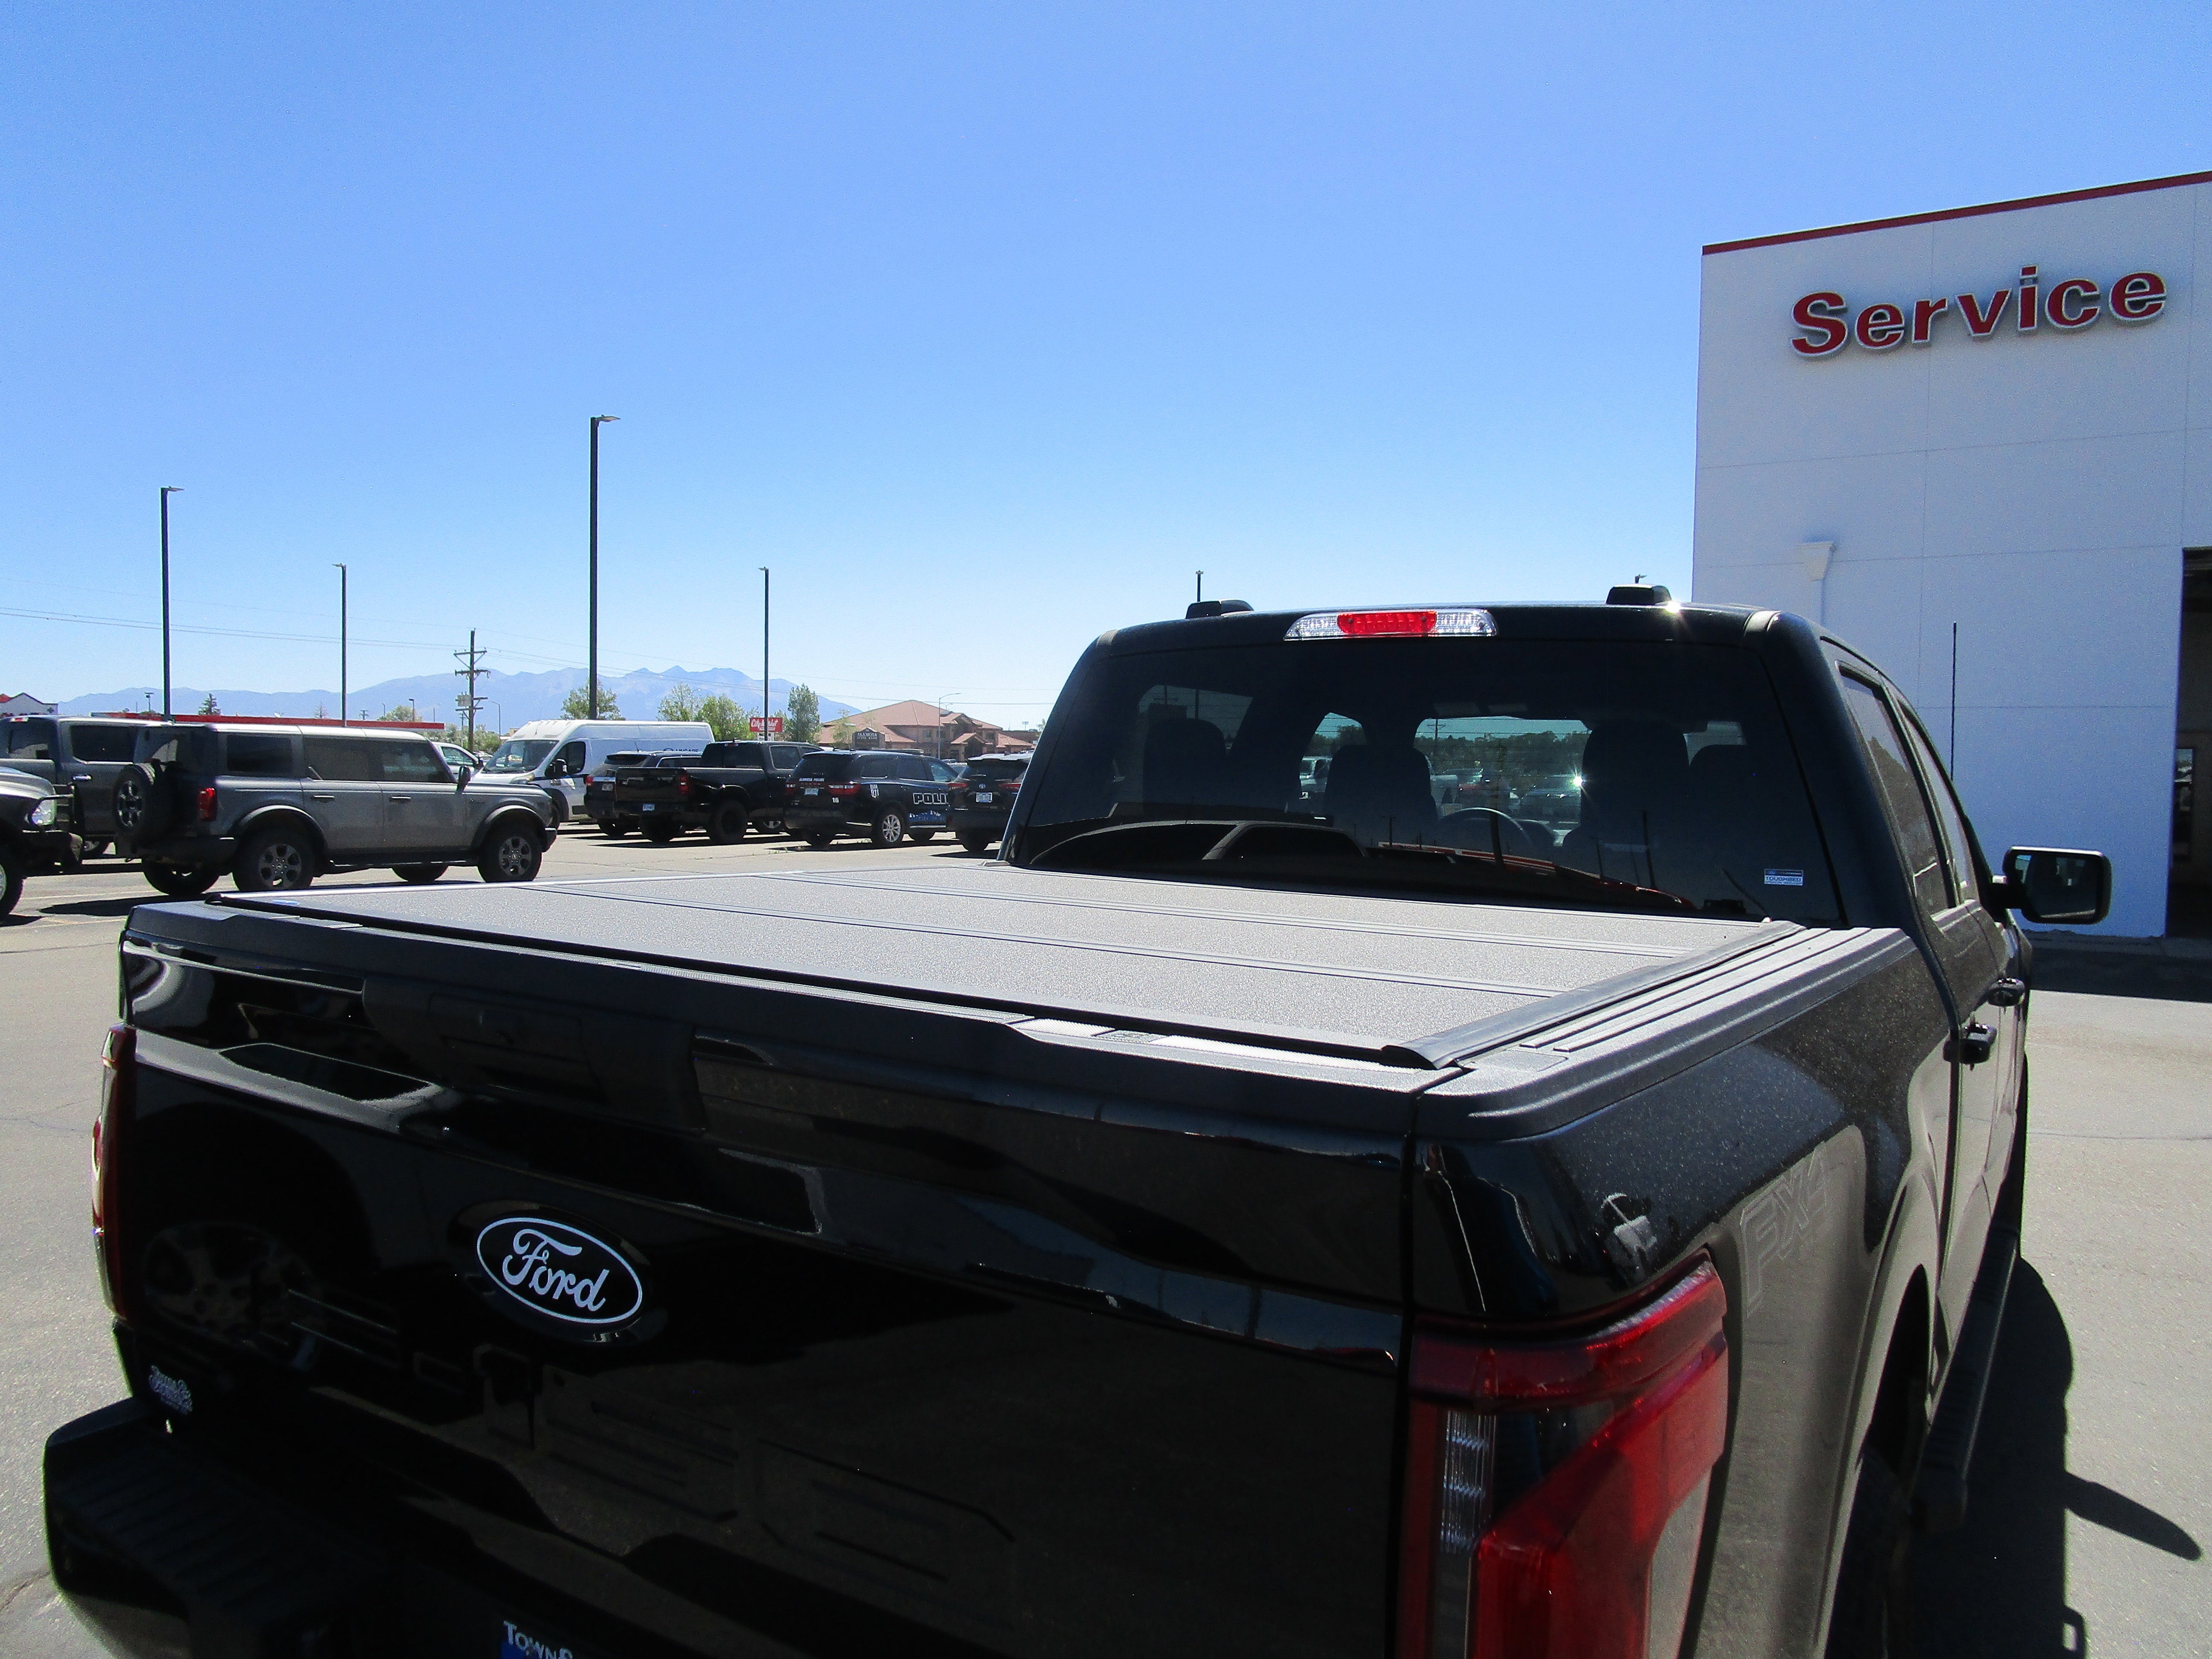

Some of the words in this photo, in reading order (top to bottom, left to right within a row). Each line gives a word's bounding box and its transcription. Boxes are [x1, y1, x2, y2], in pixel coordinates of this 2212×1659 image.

[1791, 265, 2166, 358] Service
[913, 793, 949, 805] POLI
[502, 1228, 610, 1312] Ford
